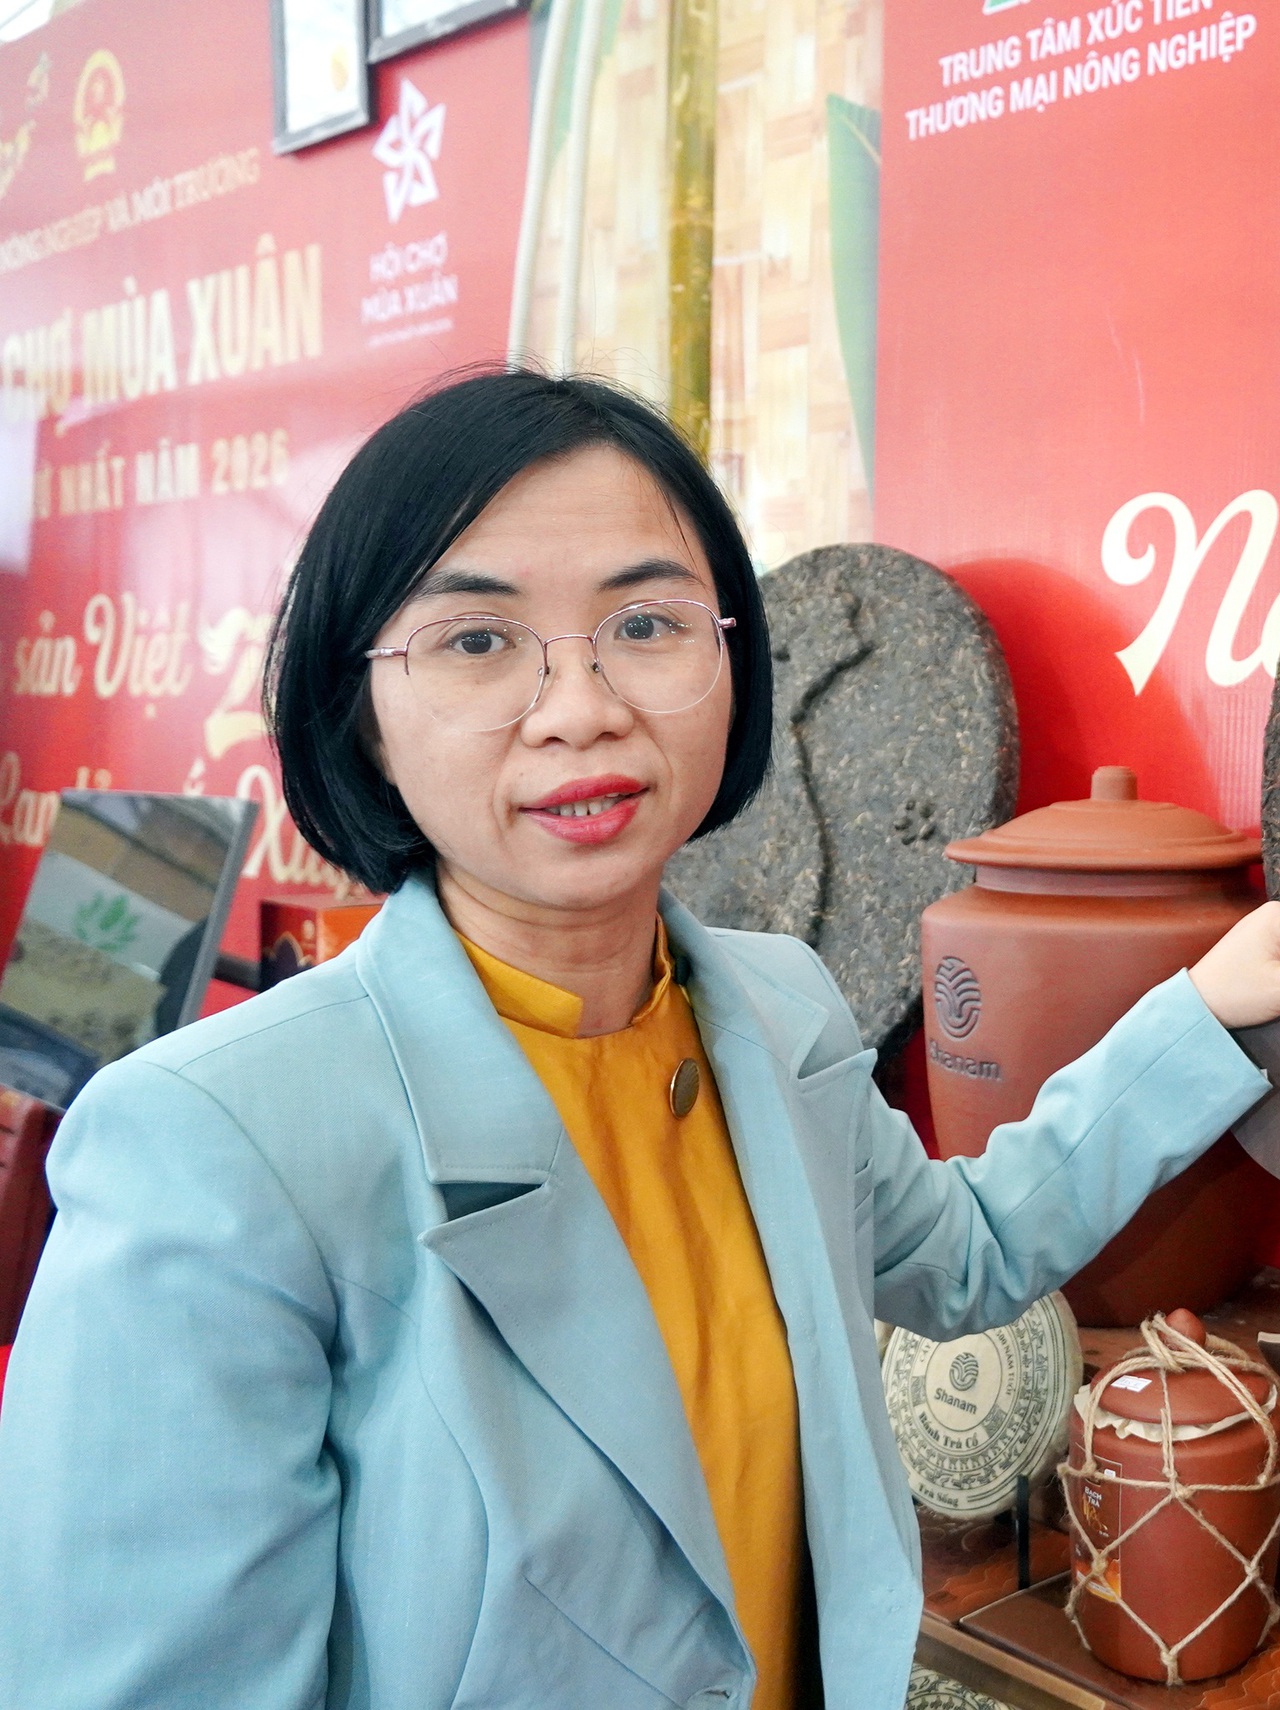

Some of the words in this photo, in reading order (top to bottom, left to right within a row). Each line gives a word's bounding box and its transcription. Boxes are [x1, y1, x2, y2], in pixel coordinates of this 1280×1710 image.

[905, 86, 1005, 141] THƯƠNG
[1009, 70, 1058, 113] MẠI
[1062, 50, 1141, 98] NÔNG
[1147, 11, 1257, 76] NGHIỆP
[939, 36, 1021, 87] TRUNG
[1025, 17, 1081, 62] TÂM
[82, 274, 178, 408] MÙA
[185, 233, 321, 386] XUÂN
[211, 428, 289, 494] 2026
[84, 592, 193, 719] Việt
[934, 1387, 977, 1415] Shanam
[943, 1433, 963, 1449] Trà
